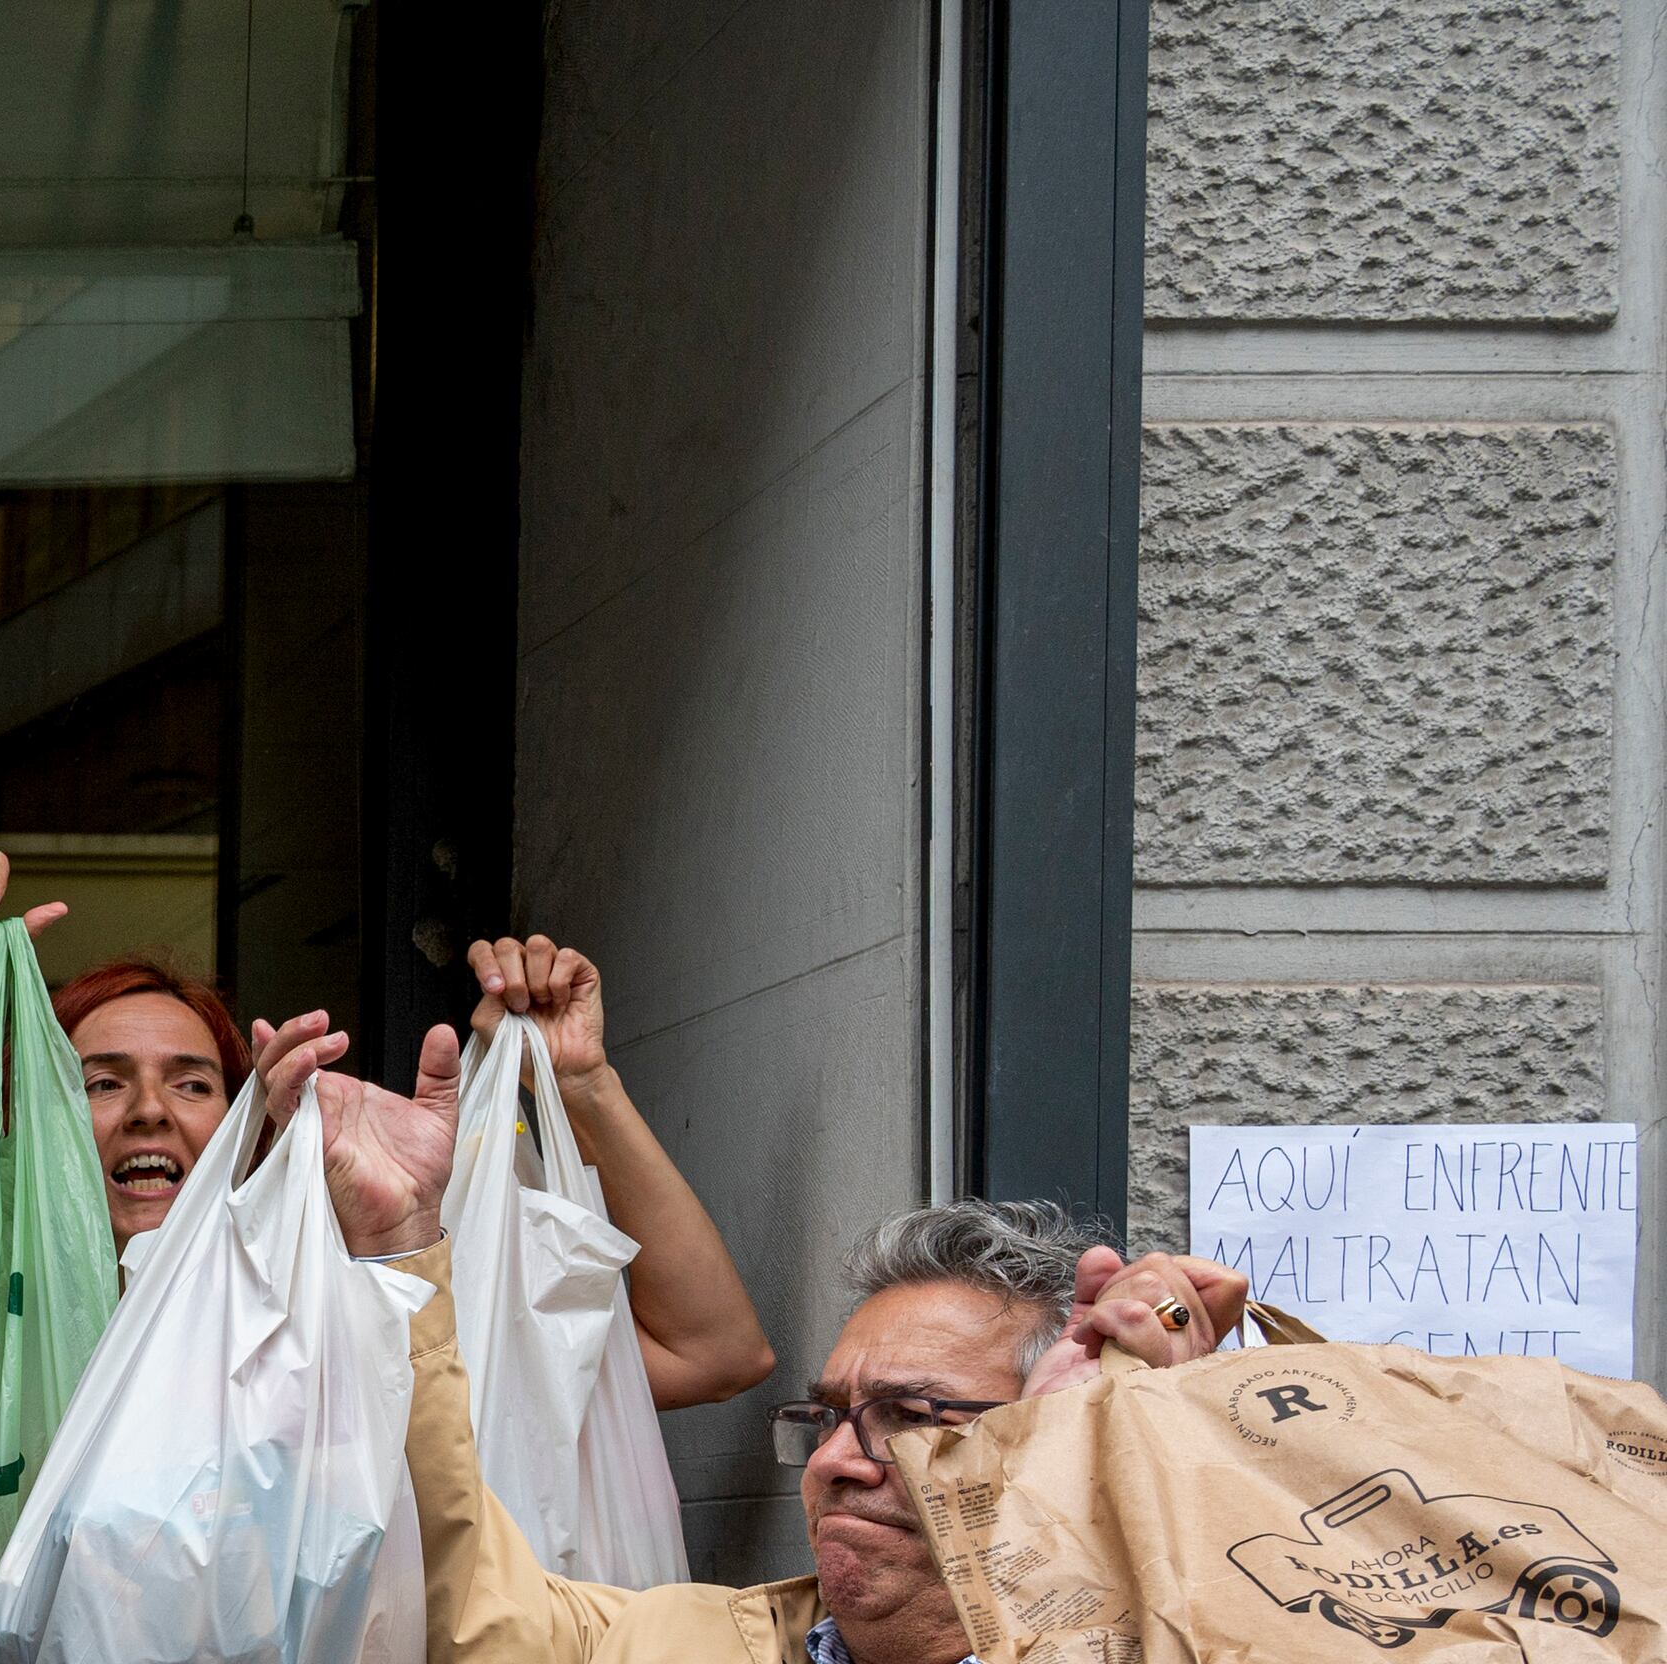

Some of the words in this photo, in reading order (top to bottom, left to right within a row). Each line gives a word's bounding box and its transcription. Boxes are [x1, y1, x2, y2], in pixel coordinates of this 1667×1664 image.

[1208, 1128, 1360, 1212] AQUÍ
[1404, 1141, 1636, 1212] ENFRENTE
[1213, 1233, 1581, 1305] MALTRATAN
[1228, 1370, 1275, 1422] ELABORADO
[1255, 1385, 1328, 1423] R
[1350, 1535, 1436, 1571] AHORA
[1346, 1590, 1361, 1600] A
[1366, 1562, 1494, 1605] DOMICILIO
